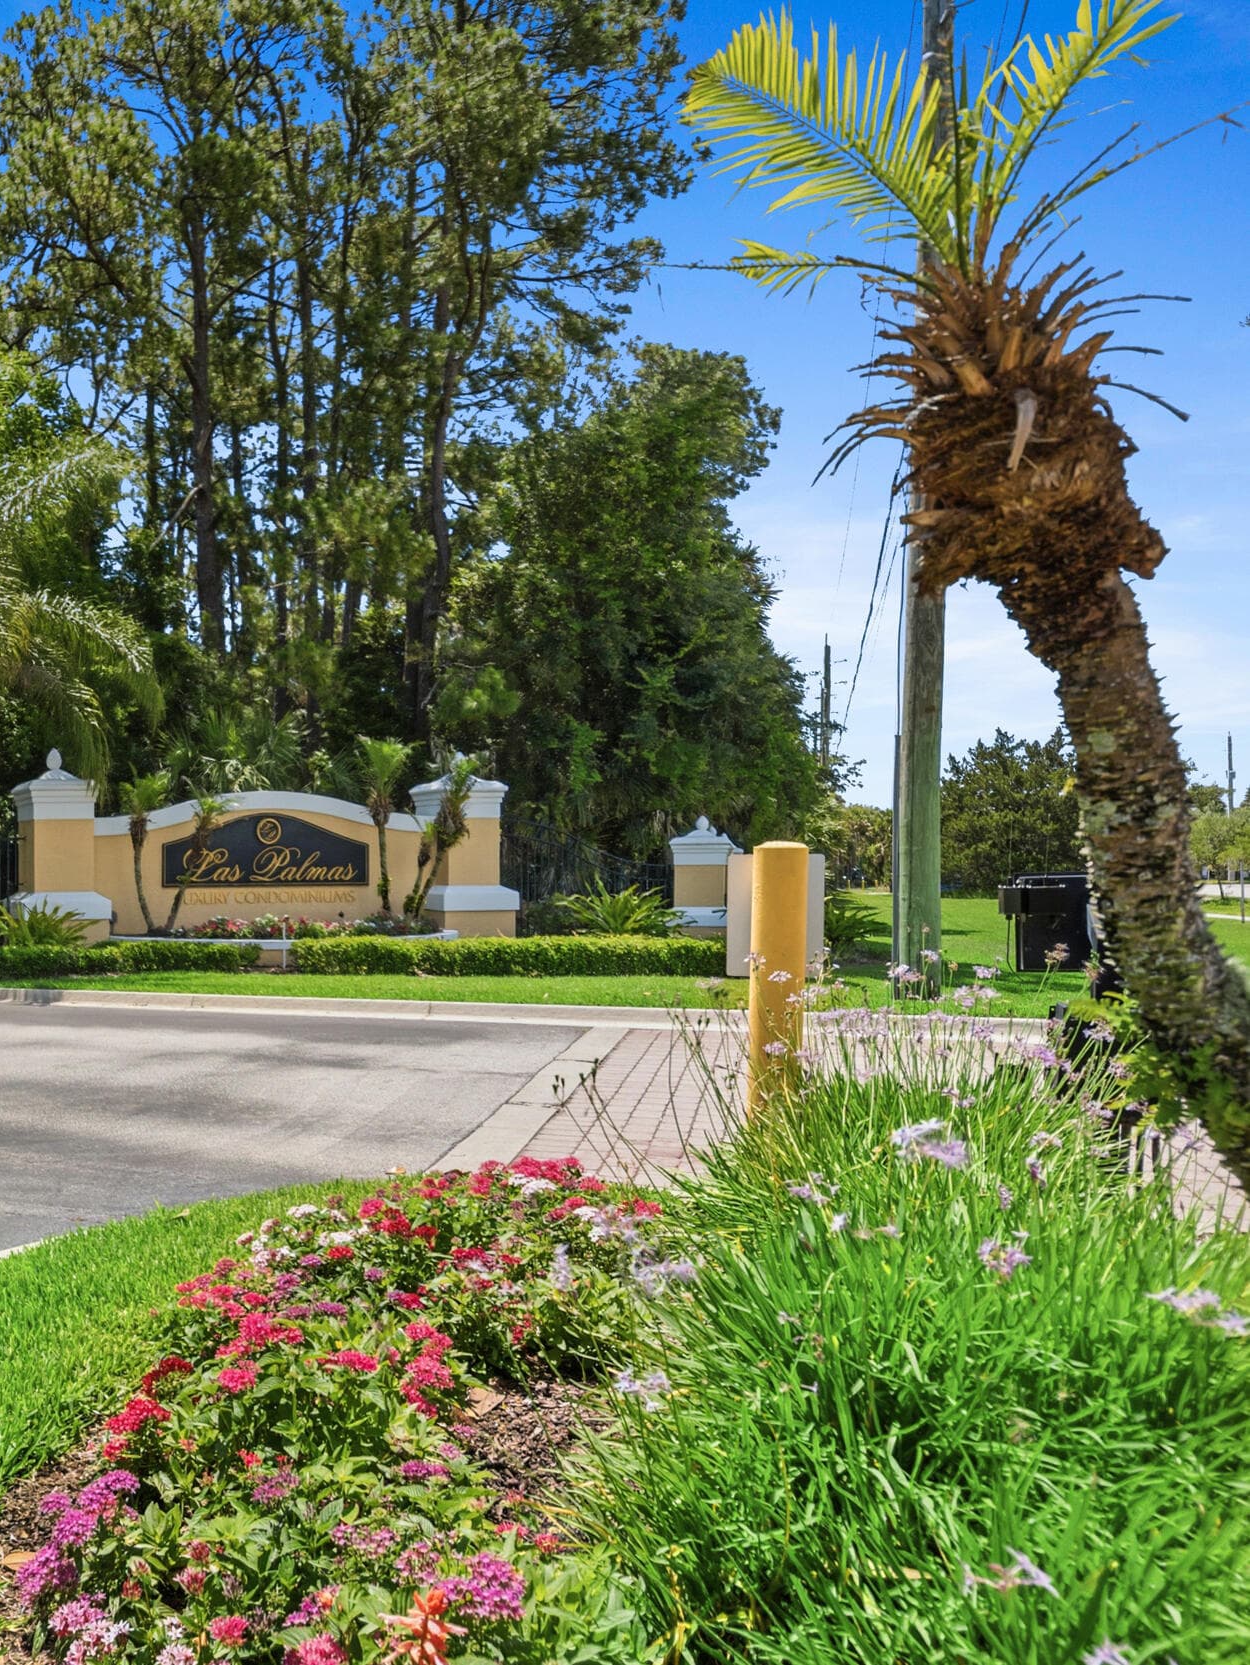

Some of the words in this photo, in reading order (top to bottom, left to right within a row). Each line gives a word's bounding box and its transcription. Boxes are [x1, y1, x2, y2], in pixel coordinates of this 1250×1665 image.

[183, 848, 245, 882] Las
[250, 845, 358, 882] Palmas
[178, 889, 229, 905] UXURY
[234, 889, 356, 905] CONDOMINIUMS
